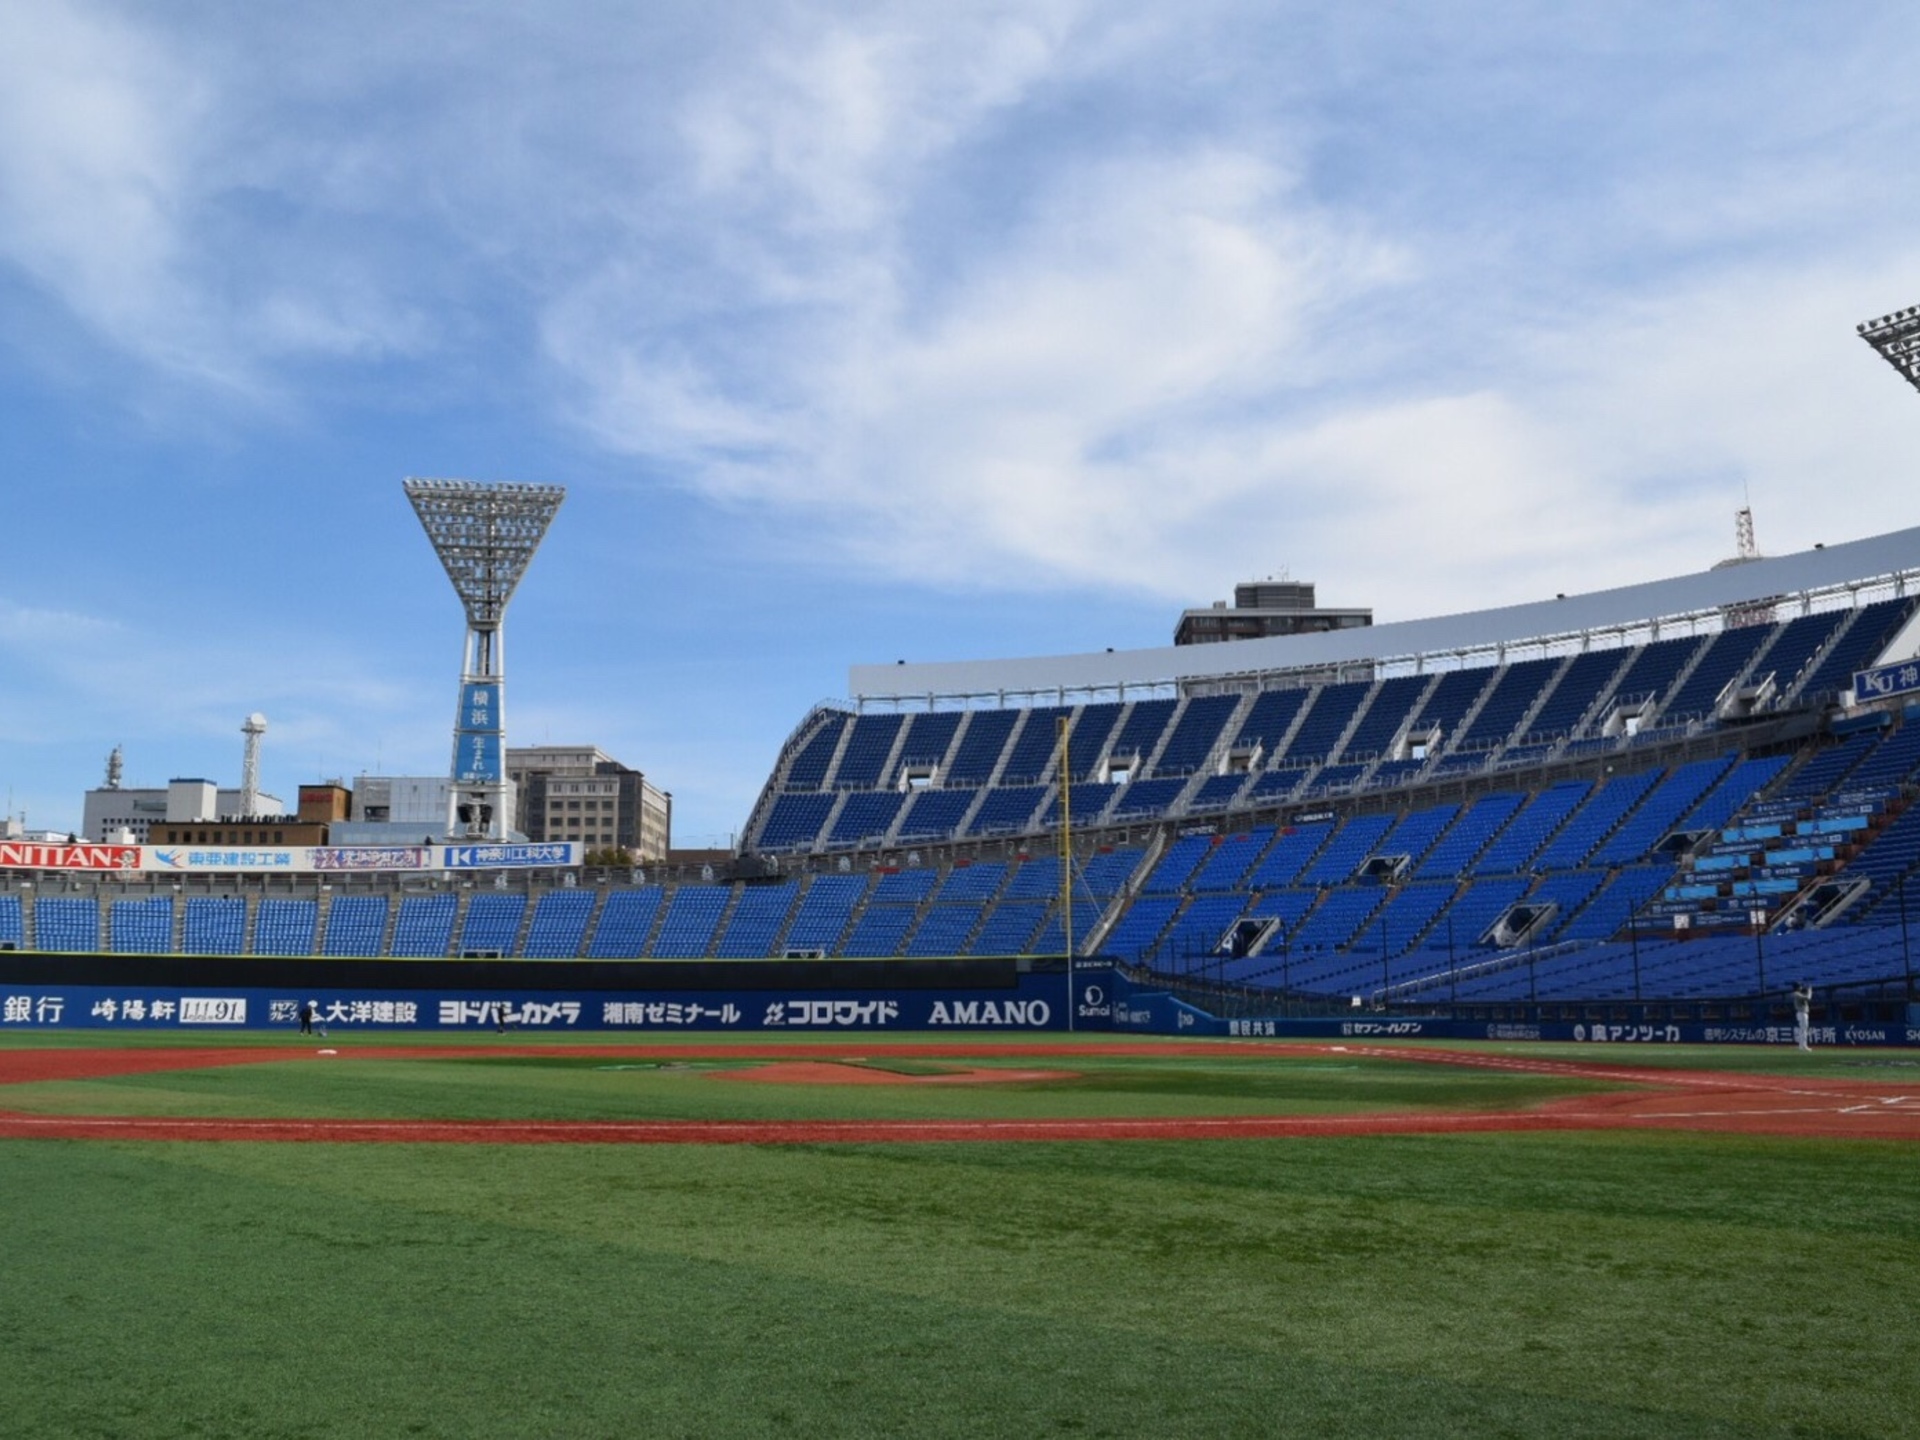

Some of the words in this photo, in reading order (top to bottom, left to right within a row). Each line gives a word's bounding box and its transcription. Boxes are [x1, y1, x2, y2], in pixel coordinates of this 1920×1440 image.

[0, 844, 112, 867] NITTAN
[188, 851, 291, 866] 東亜建設工業
[475, 846, 565, 862] 神奈川工科大学
[3, 996, 64, 1023] 銀行
[91, 998, 176, 1021] 崎陽軒
[325, 1001, 417, 1023] 大洋建設
[439, 1001, 581, 1024] ヨドバシカメラ
[603, 1002, 741, 1024] 湘南ゼミナール
[788, 1001, 899, 1024] コロワイド
[928, 1000, 1050, 1025] AMANO
